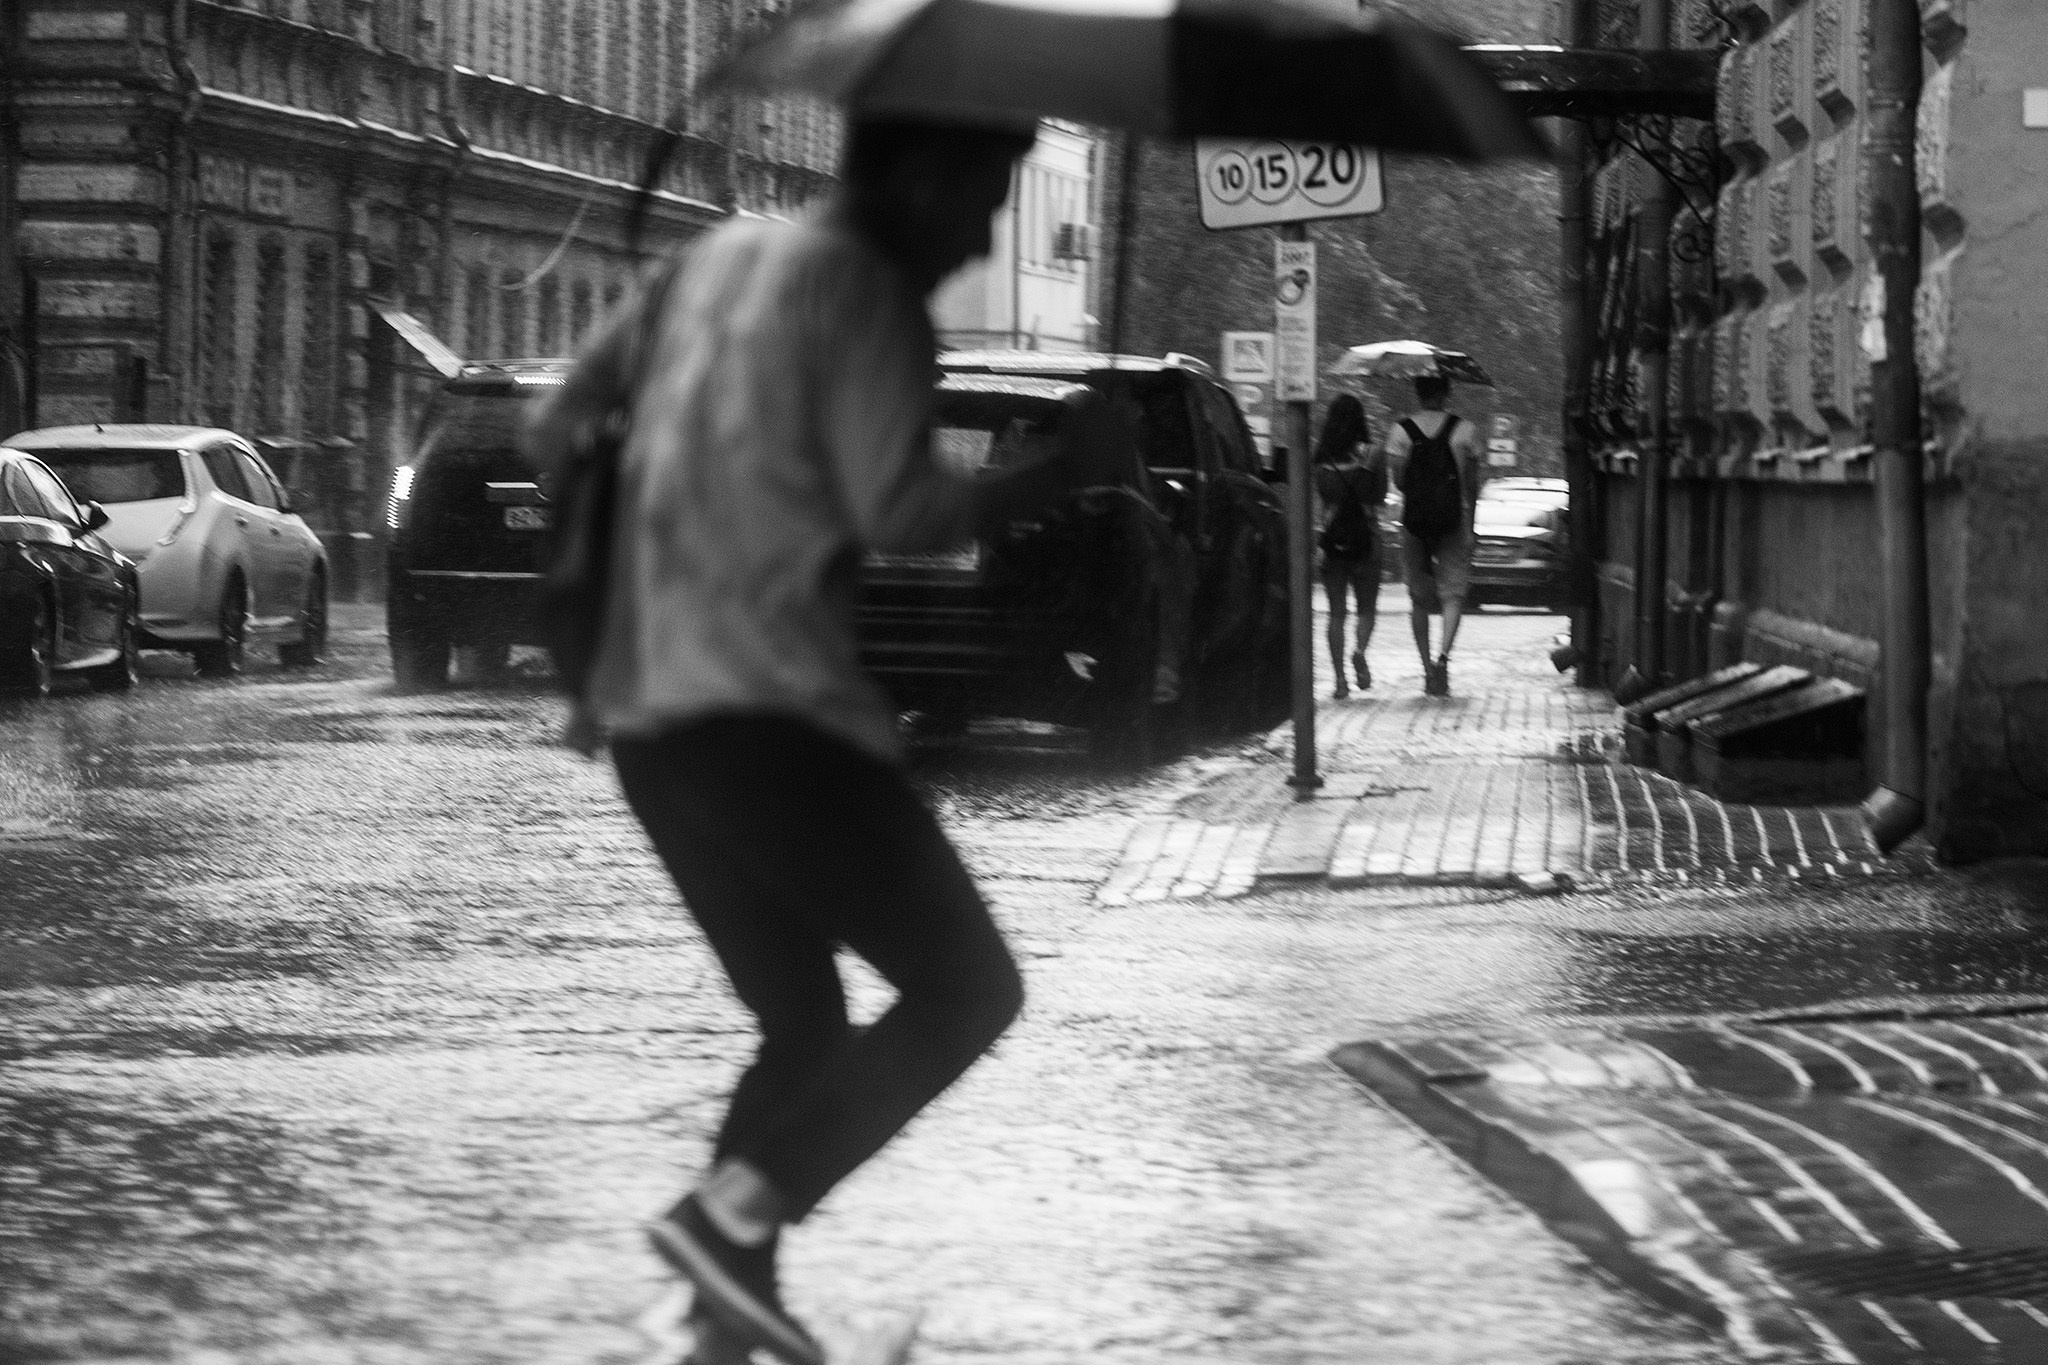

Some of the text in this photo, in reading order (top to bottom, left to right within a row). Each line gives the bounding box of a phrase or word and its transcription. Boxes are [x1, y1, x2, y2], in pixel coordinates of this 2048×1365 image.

[1217, 143, 1355, 191] 10 15 20
